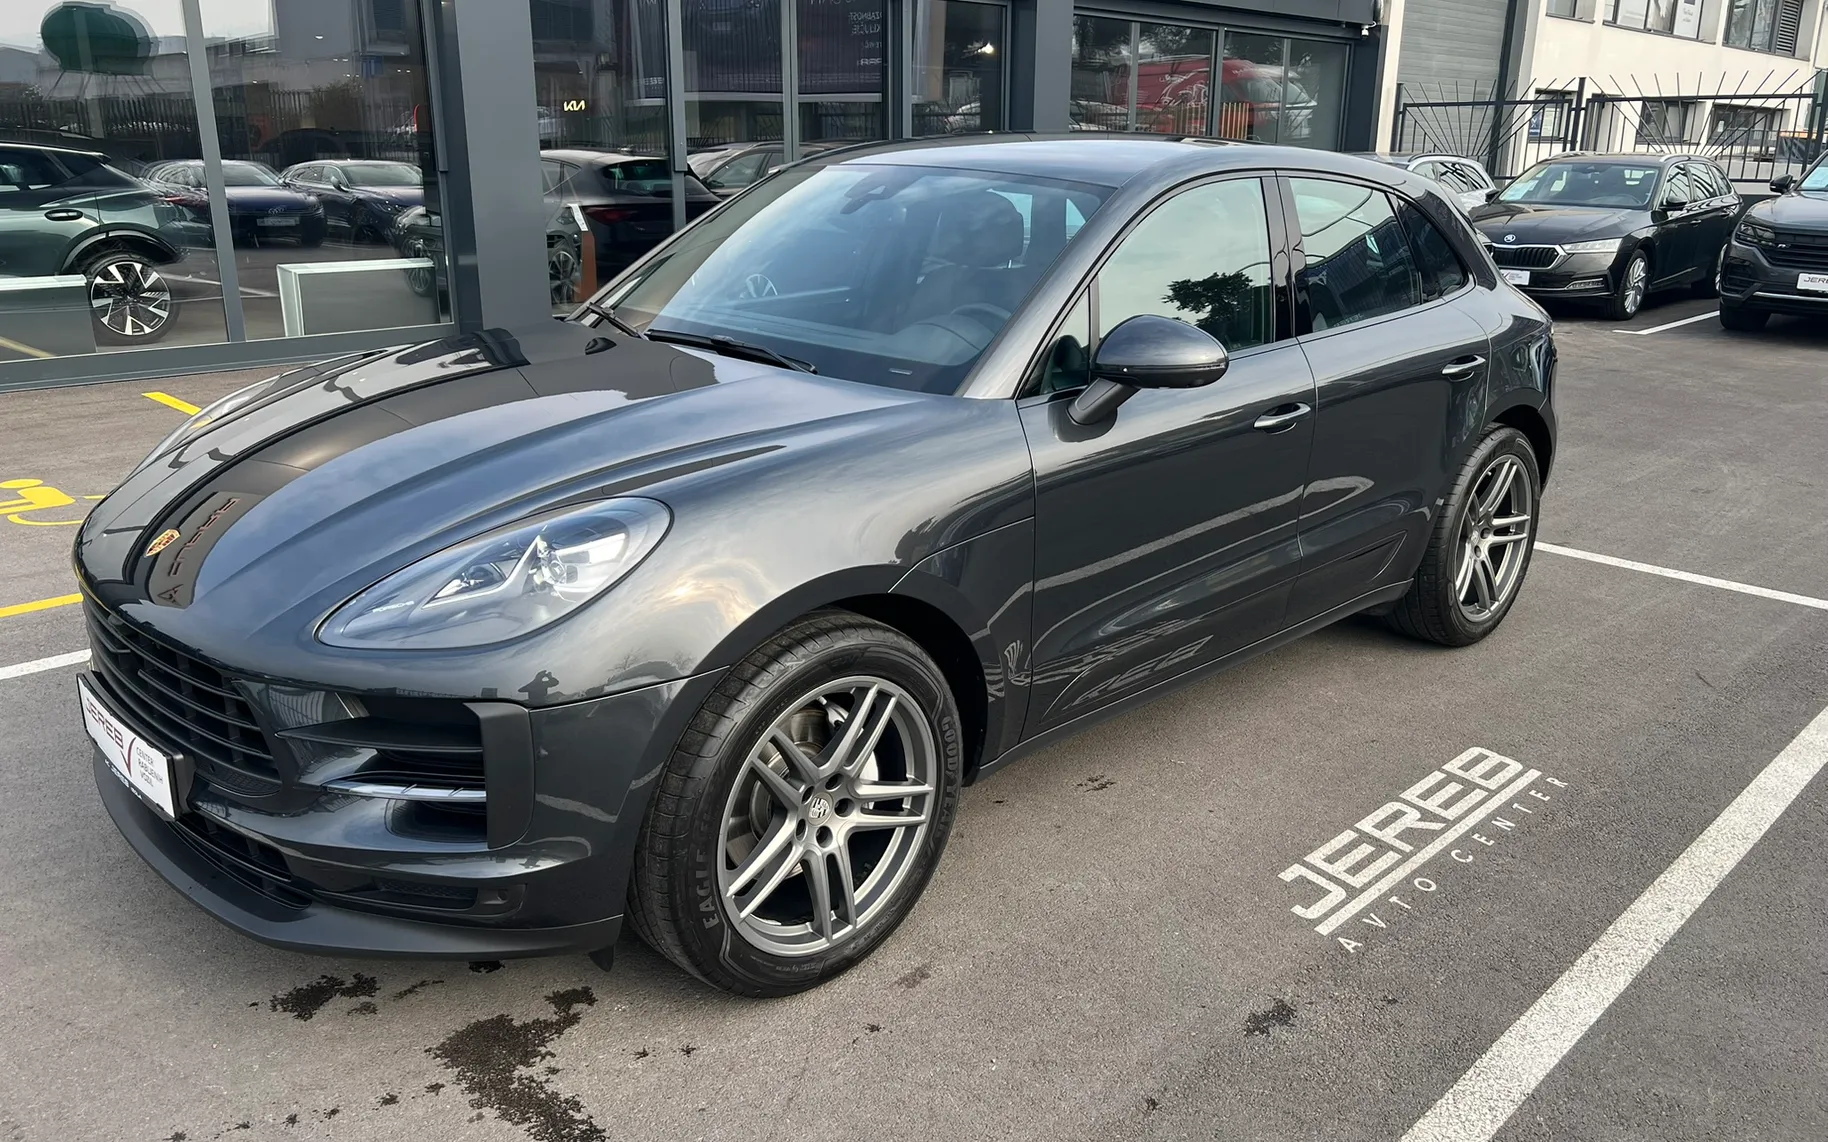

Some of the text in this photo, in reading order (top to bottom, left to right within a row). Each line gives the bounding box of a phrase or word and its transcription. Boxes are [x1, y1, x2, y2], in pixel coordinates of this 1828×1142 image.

[563, 100, 586, 112] KIA
[85, 697, 124, 750] JEREB
[136, 746, 154, 766] CENTER
[1277, 746, 1524, 919] JEREB
[1337, 776, 1569, 953] AVTO CENTER
[695, 848, 720, 930] EAGLE
